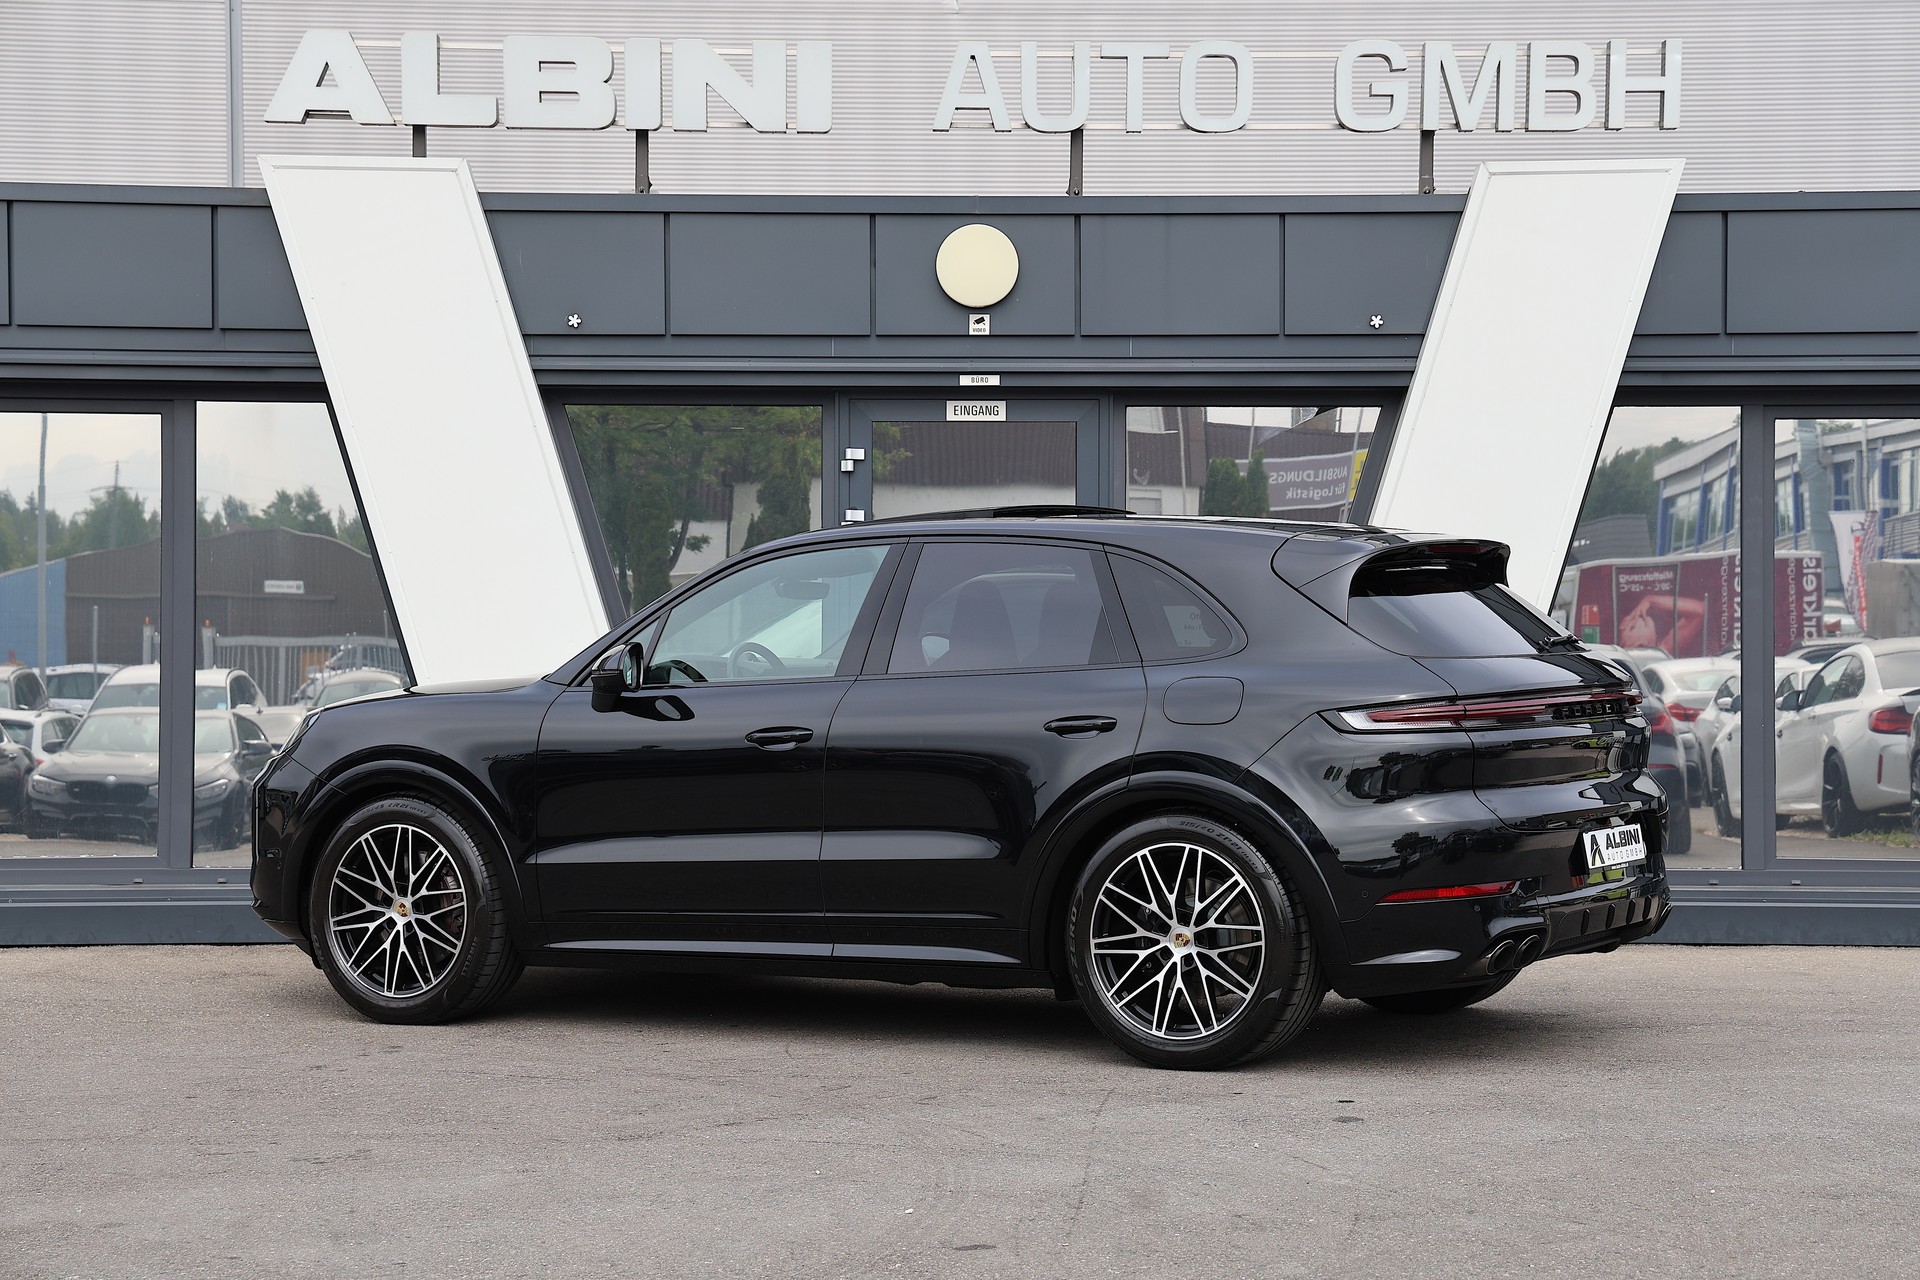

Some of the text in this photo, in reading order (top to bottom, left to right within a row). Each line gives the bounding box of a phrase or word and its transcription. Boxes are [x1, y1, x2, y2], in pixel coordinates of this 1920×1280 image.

[264, 29, 1684, 135] ALBINI AUTO GMBH
[970, 375, 989, 384] BÜRO
[953, 405, 1000, 416] EINGANG
[1606, 828, 1641, 850] ALBINI
[1607, 847, 1643, 861] AUTO GMBH
